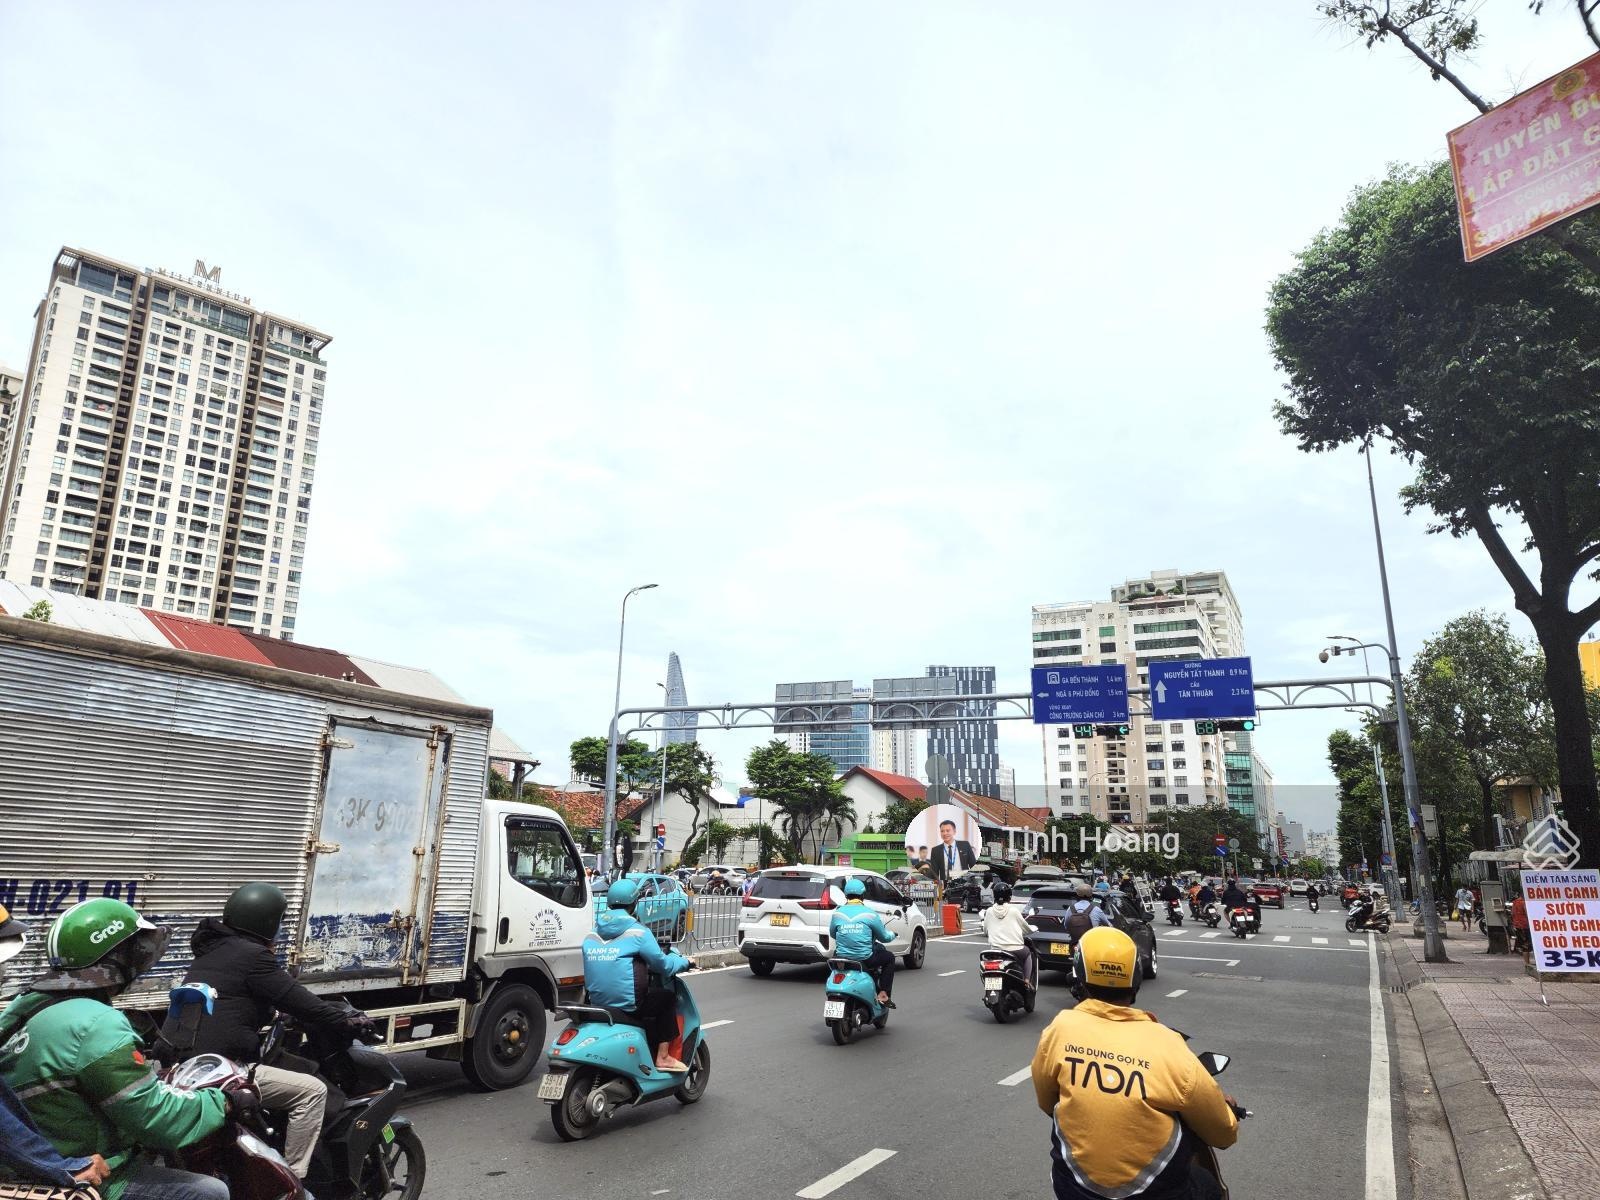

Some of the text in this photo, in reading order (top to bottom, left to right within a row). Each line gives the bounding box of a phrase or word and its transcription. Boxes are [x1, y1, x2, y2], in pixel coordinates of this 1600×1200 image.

[159, 267, 251, 305] MILLENNIUM
[1061, 676, 1070, 684] GA
[1069, 674, 1080, 684] BẾN
[1080, 674, 1099, 684] THÀNH
[1164, 669, 1190, 679] NGUYỄN
[1190, 668, 1202, 678] TẤT
[1204, 668, 1225, 677] THÀNH
[1178, 690, 1191, 698] TÂN
[1192, 689, 1213, 697] THUẬN
[1049, 711, 1062, 720] CÔNG
[1083, 711, 1094, 719] DÂN
[1075, 725, 1092, 737] 44
[1525, 873, 1548, 883] ĐIỂM
[1571, 873, 1597, 883] SÁNG
[1527, 885, 1599, 899] BÁNH CANH
[1545, 901, 1586, 915] SƯỜN
[90, 919, 125, 944] Grab
[1532, 917, 1567, 932] BÁNH
[1542, 933, 1600, 948] GIÒ HEO
[1100, 963, 1122, 972] TADA
[1064, 1042, 1150, 1070] ỨNG DỤNG GỌI XE
[1064, 1056, 1147, 1100] TADA
